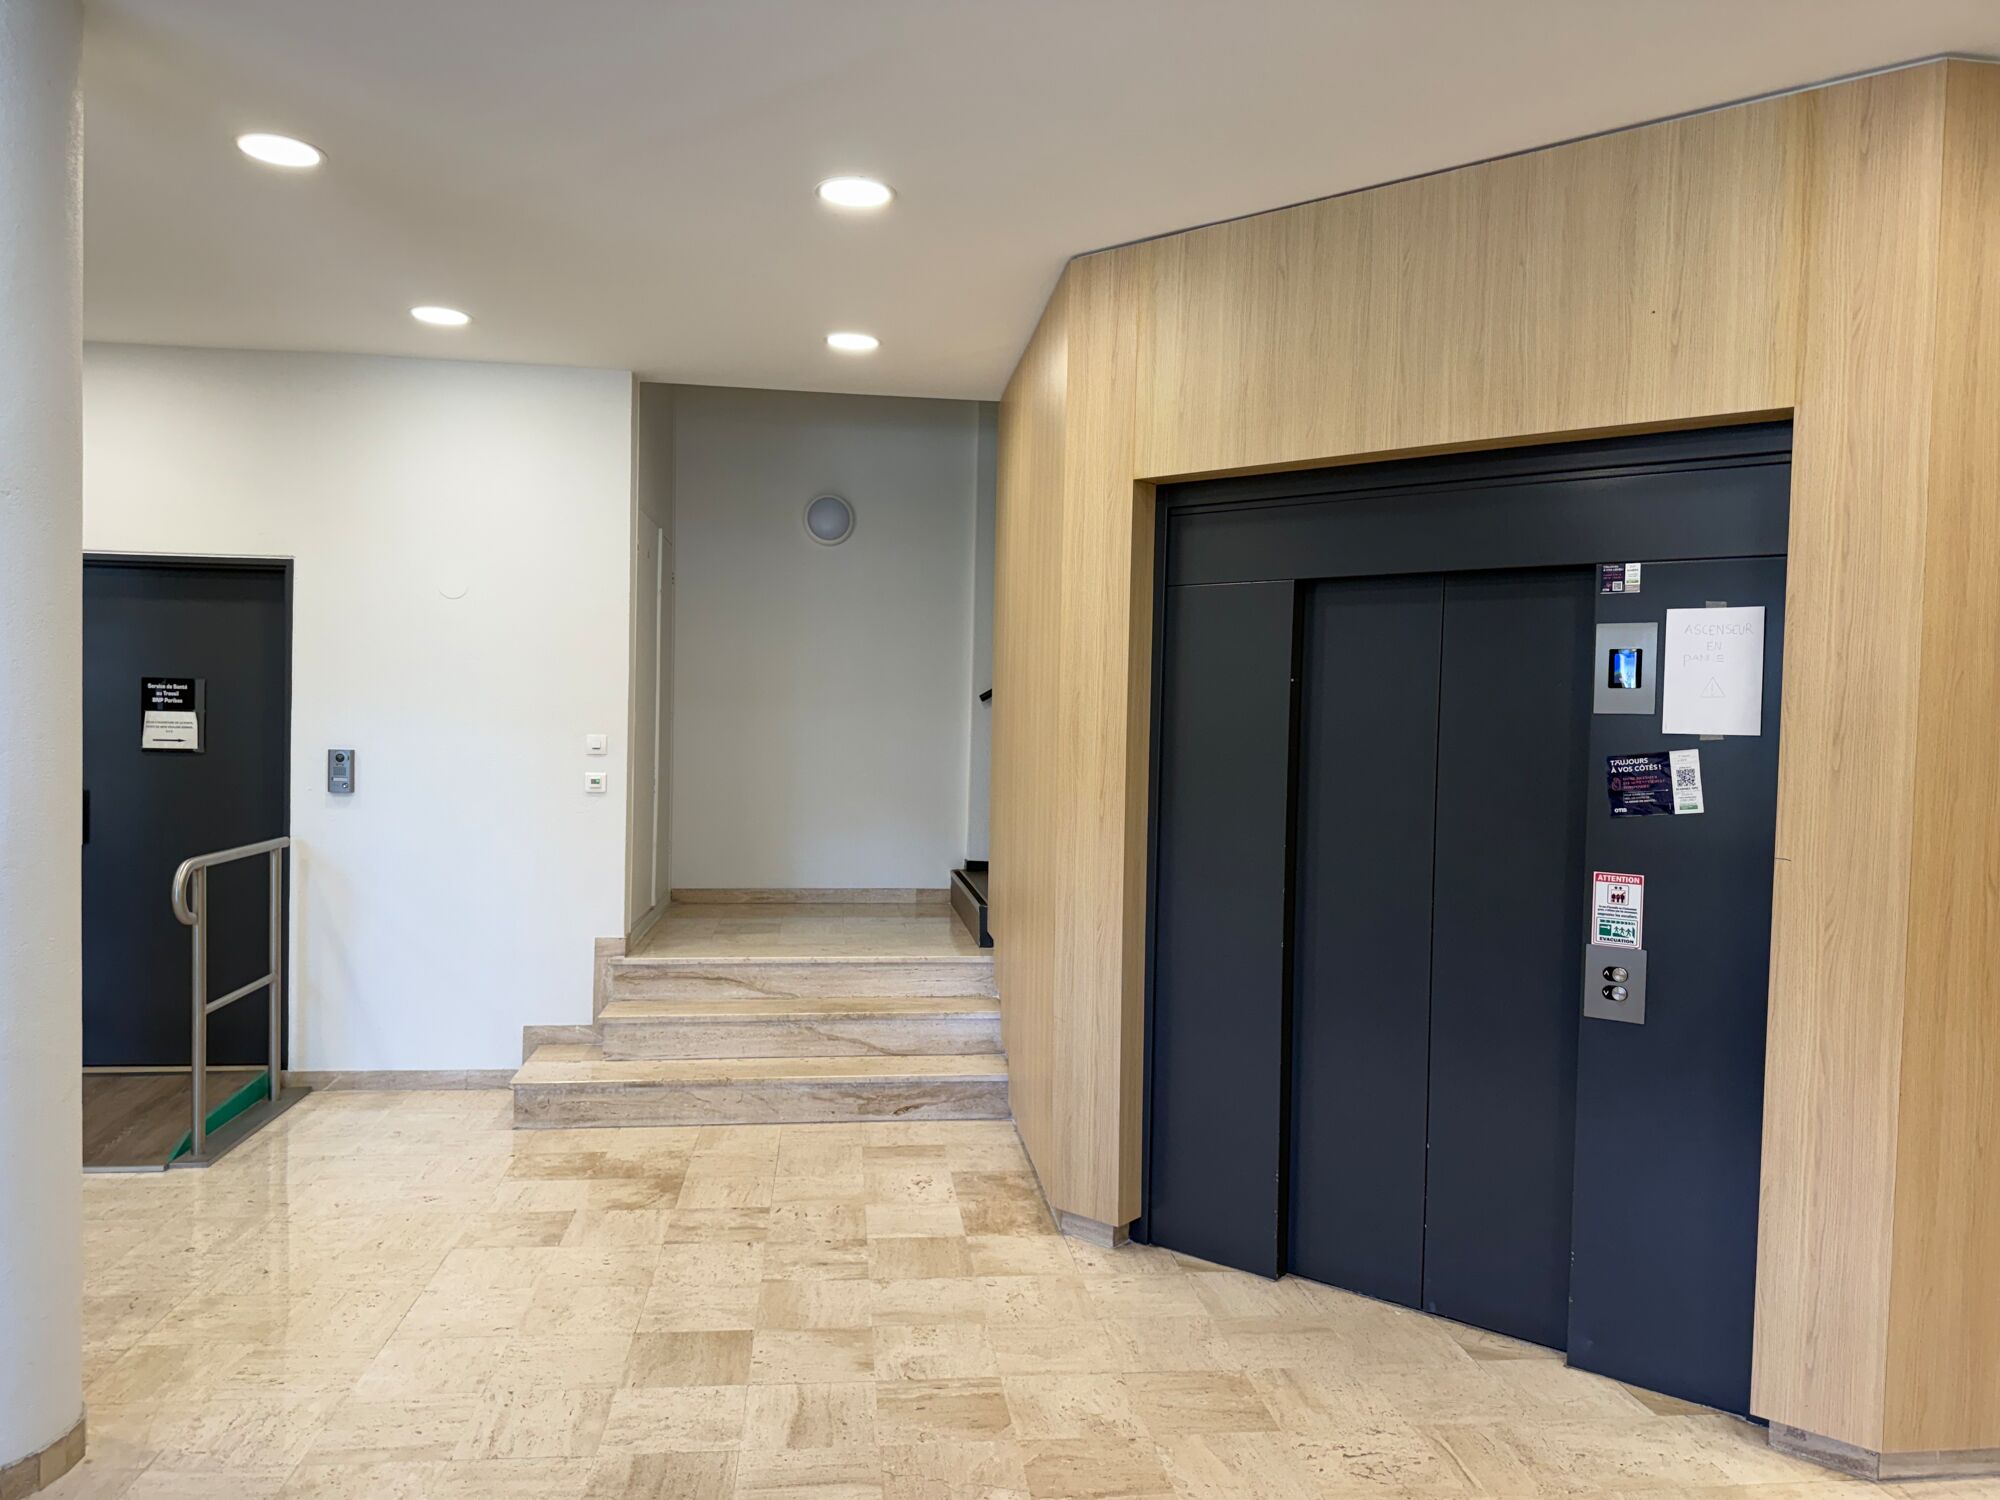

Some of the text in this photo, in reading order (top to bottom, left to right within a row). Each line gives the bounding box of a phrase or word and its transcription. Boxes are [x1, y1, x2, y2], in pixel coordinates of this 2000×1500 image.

[1684, 623, 1754, 635] ASCENSEUR
[1707, 641, 1722, 651] EN
[1683, 653, 1725, 667] PANE
[1611, 766, 1617, 774] À
[1634, 764, 1658, 772] CÔTÉS
[1597, 875, 1640, 883] ATTENTION
